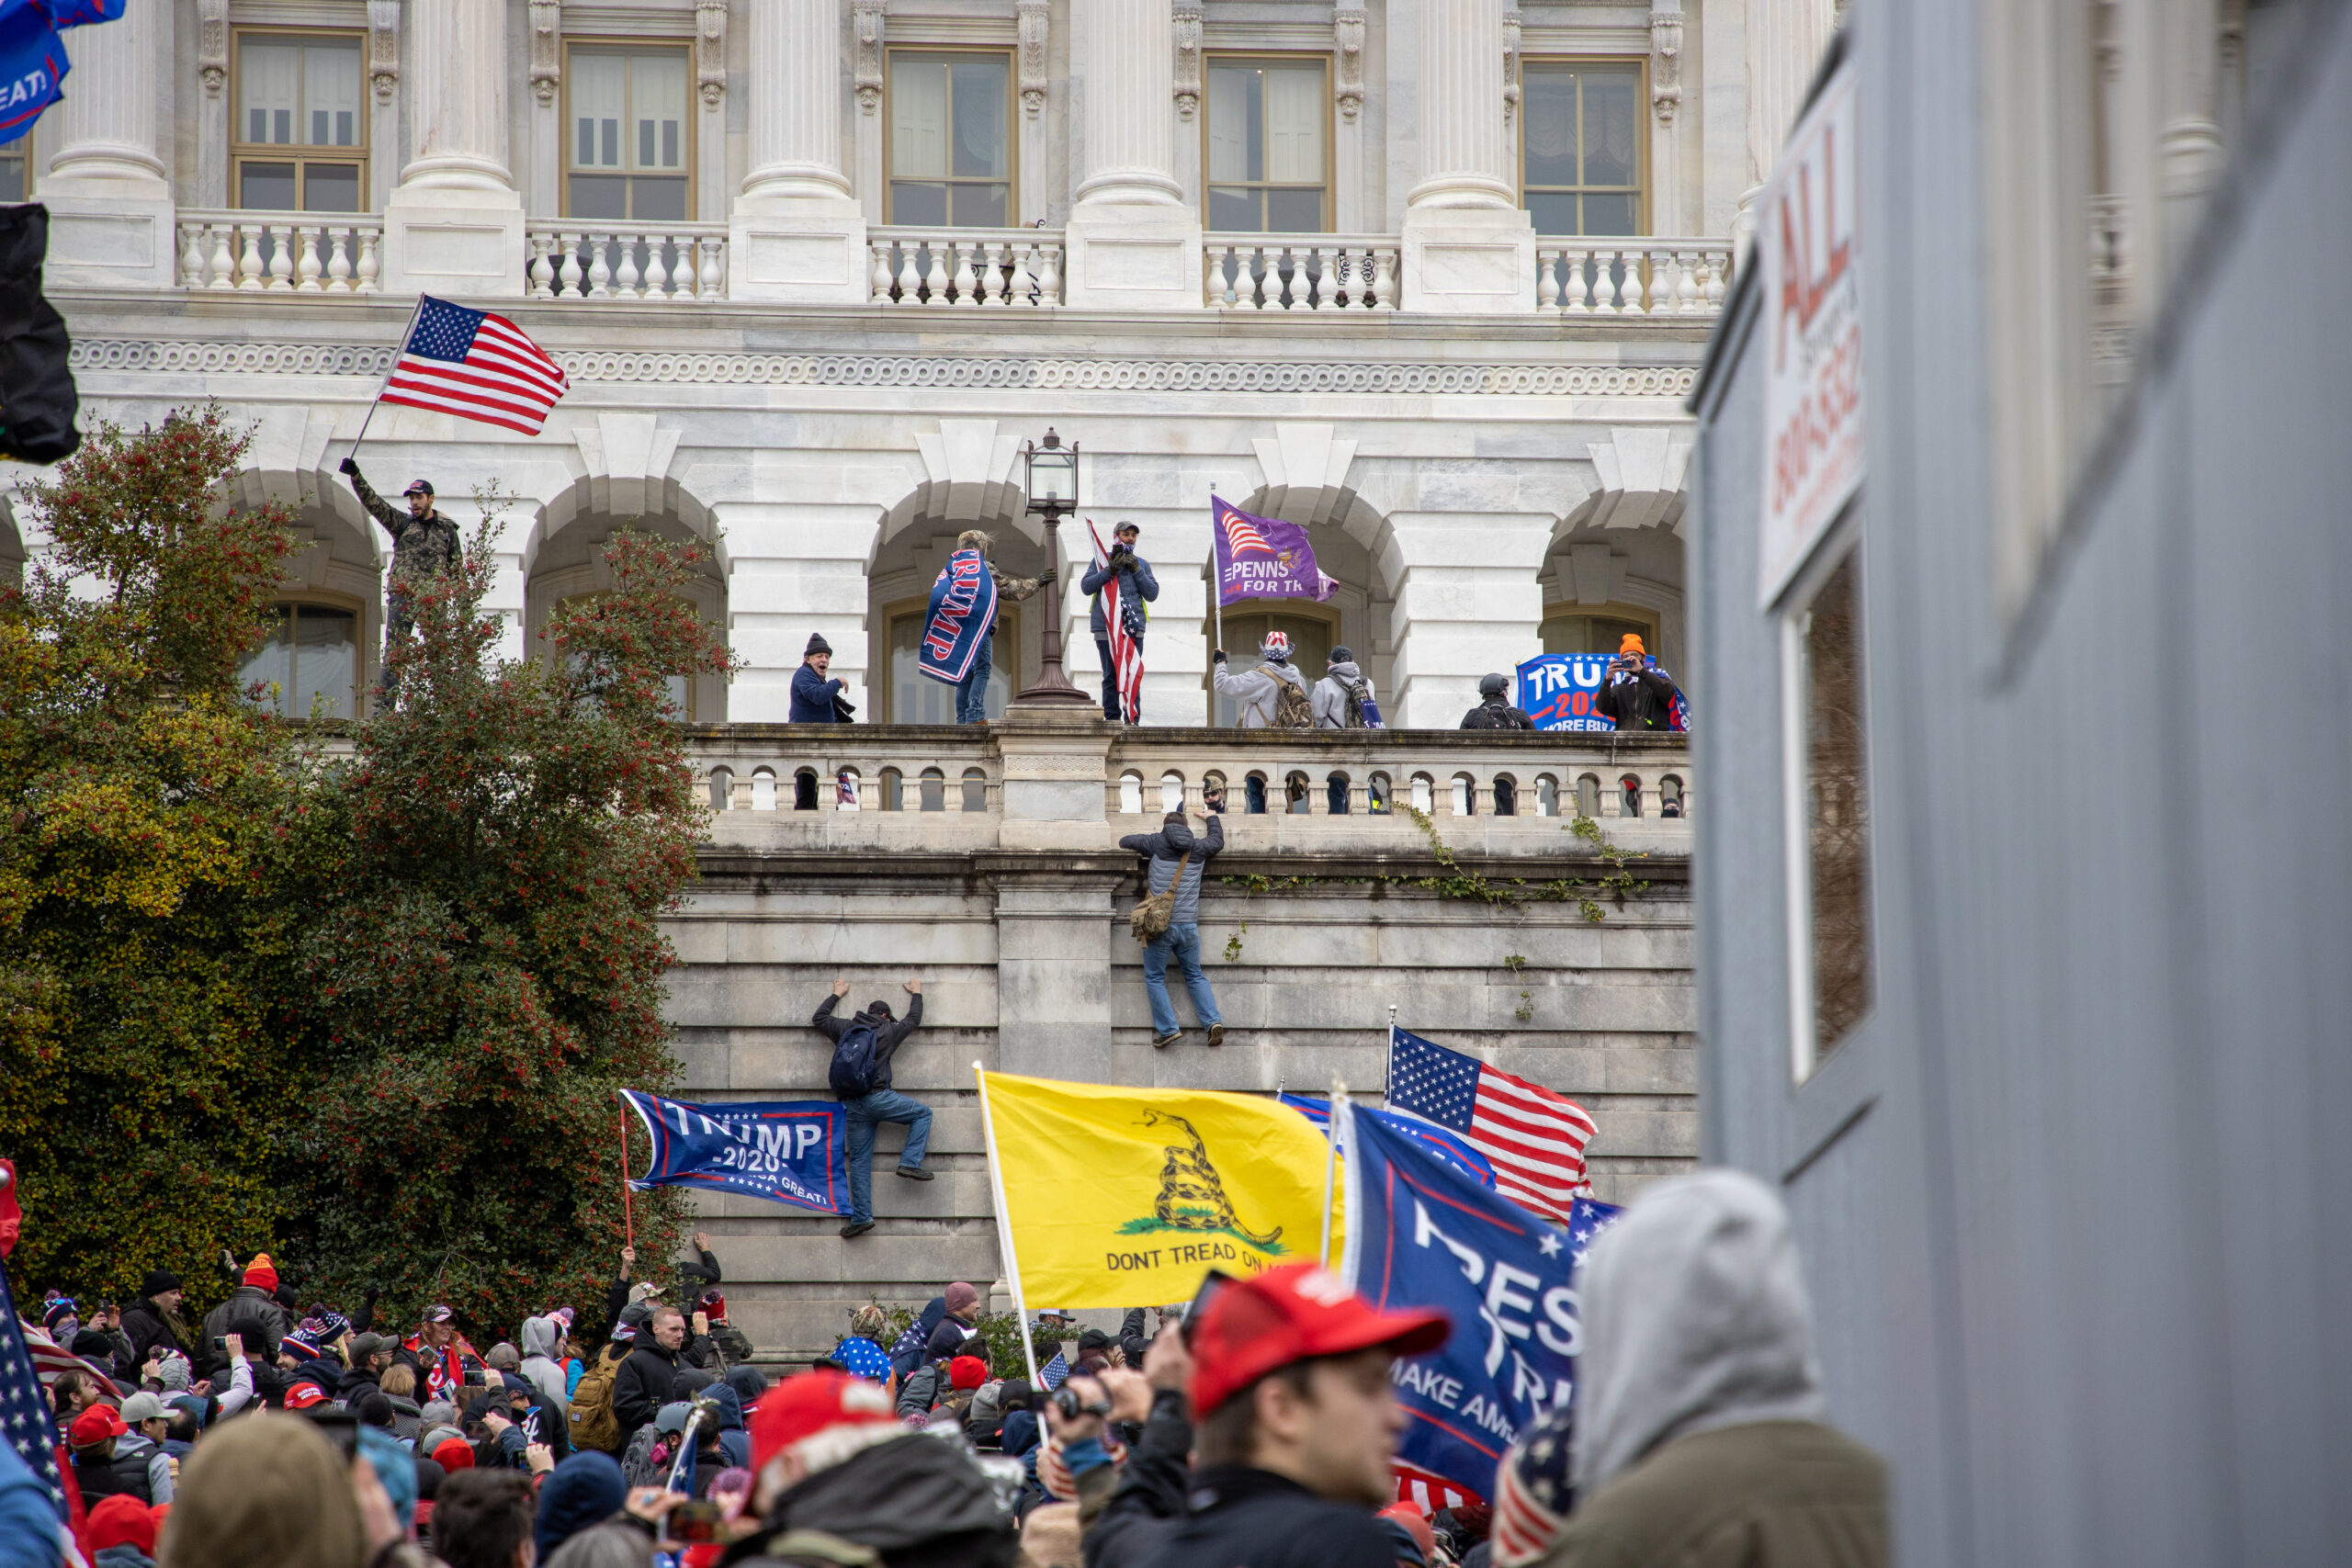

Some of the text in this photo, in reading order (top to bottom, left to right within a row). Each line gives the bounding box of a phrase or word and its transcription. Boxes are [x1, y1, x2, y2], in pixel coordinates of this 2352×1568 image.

[1243, 580, 1278, 592] FOR
[1527, 662, 1623, 701] TRU
[1555, 691, 1600, 719] 202
[1106, 1243, 1262, 1273] DONT TREAD ON
